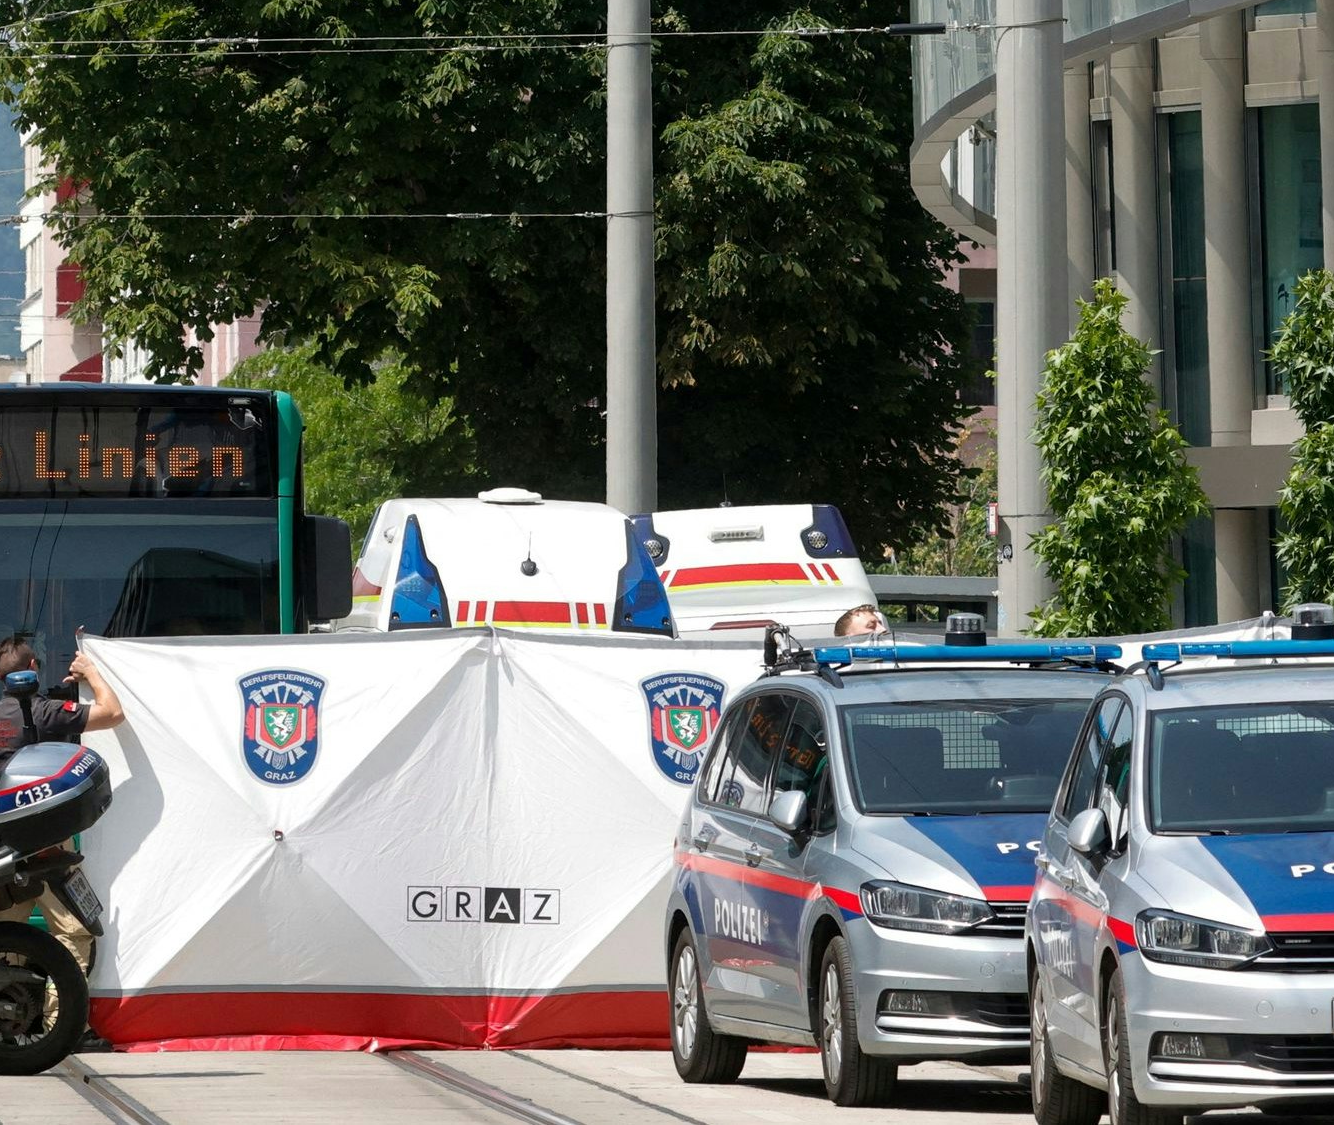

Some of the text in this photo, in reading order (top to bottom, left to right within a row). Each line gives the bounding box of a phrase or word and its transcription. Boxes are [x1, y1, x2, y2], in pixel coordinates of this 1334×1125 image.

[35, 431, 244, 479] Linien
[242, 673, 323, 689] BERUFSFEUERWEHR
[645, 676, 723, 692] BERUFSFEUERWEHR
[71, 753, 97, 777] POLIZEI
[264, 770, 297, 781] GRAZ
[15, 782, 53, 808] C133
[410, 889, 554, 922] GRAZ
[714, 897, 762, 945] POLIZEI
